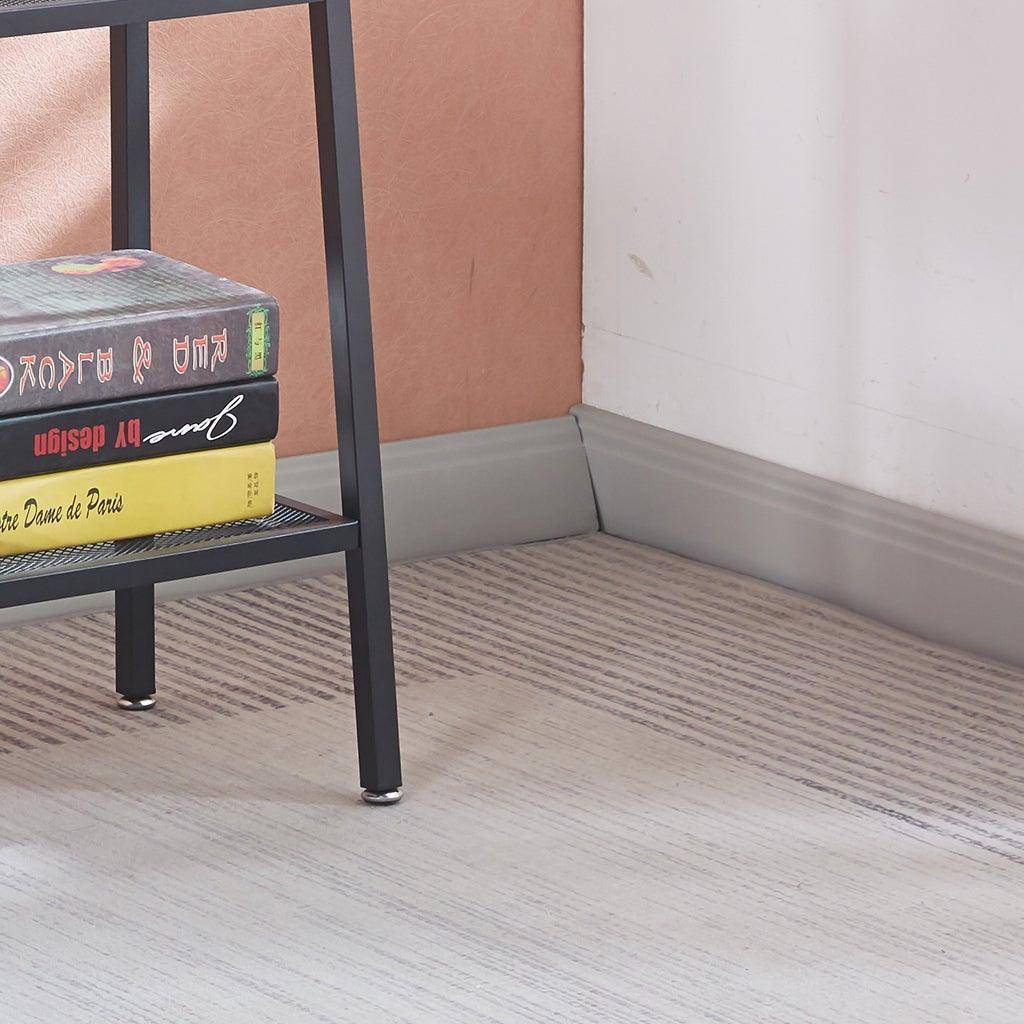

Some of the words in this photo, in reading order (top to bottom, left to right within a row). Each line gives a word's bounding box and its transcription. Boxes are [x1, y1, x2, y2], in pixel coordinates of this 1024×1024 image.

[19, 346, 114, 397] BLACK
[132, 335, 153, 386] &
[173, 327, 228, 375] RED
[33, 423, 106, 458] design
[142, 394, 245, 445] Jane
[23, 497, 63, 529] Dame
[66, 494, 83, 520] de
[85, 487, 125, 519] Paris
